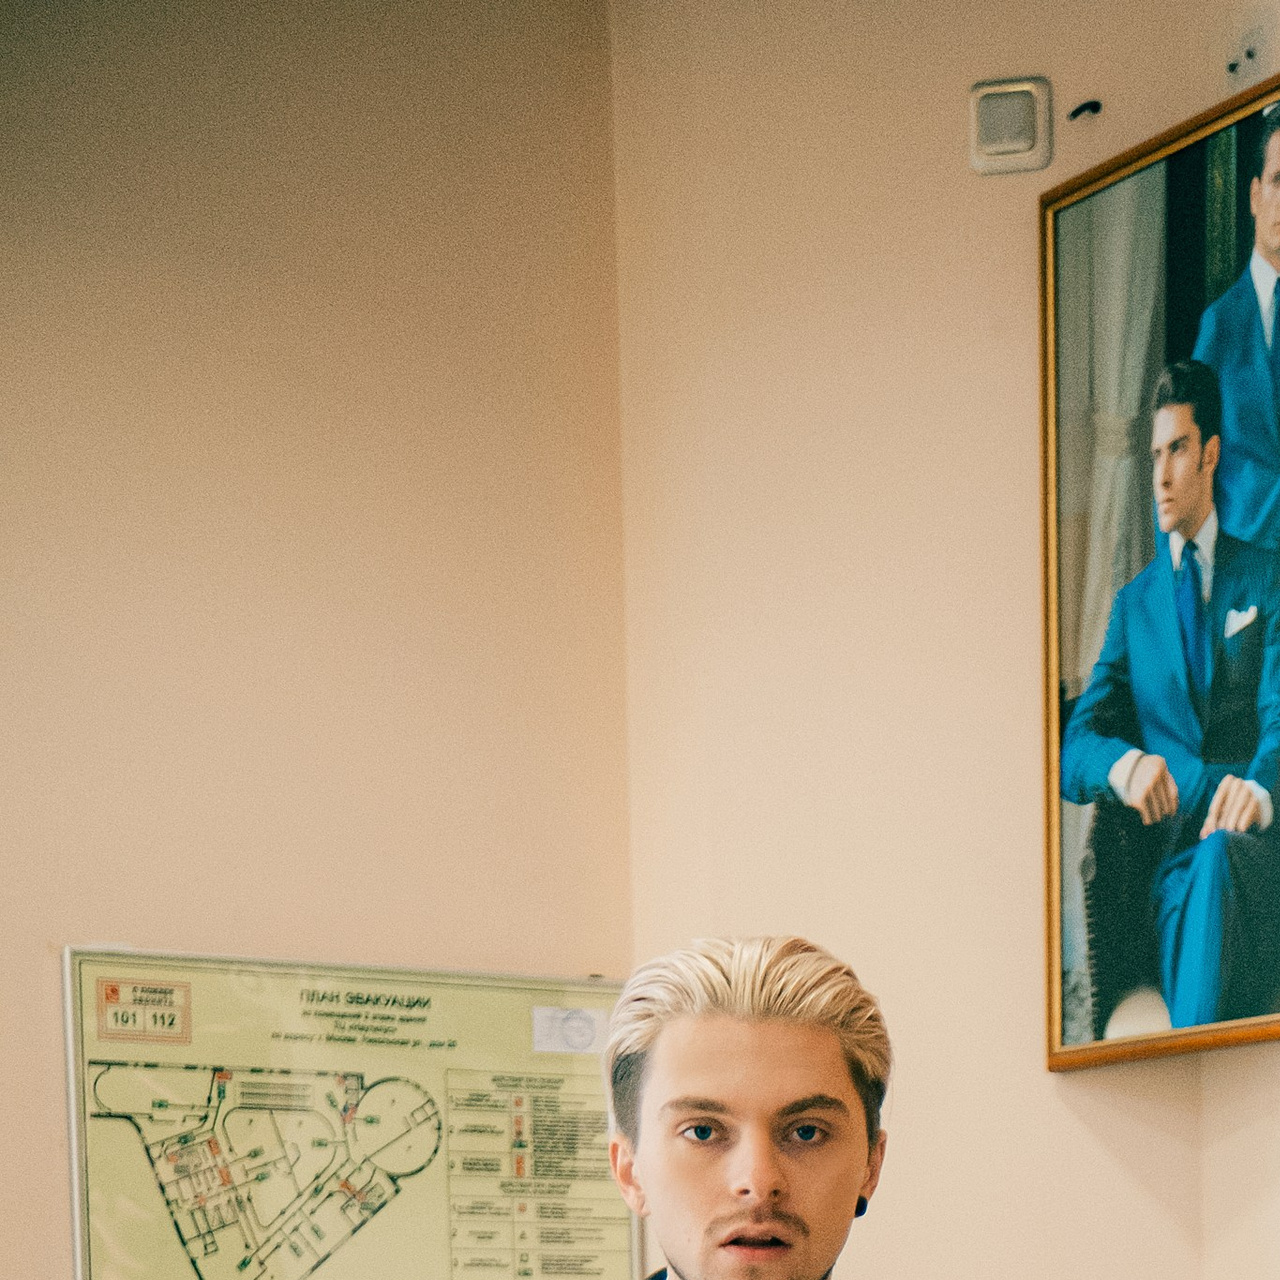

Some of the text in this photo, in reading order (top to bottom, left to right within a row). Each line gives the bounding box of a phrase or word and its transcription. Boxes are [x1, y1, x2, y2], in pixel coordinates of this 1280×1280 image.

[301, 989, 432, 1009] ПЛАН ЭВАКУАЦИИ
[113, 1010, 138, 1026] 101
[152, 1011, 177, 1028] 112
